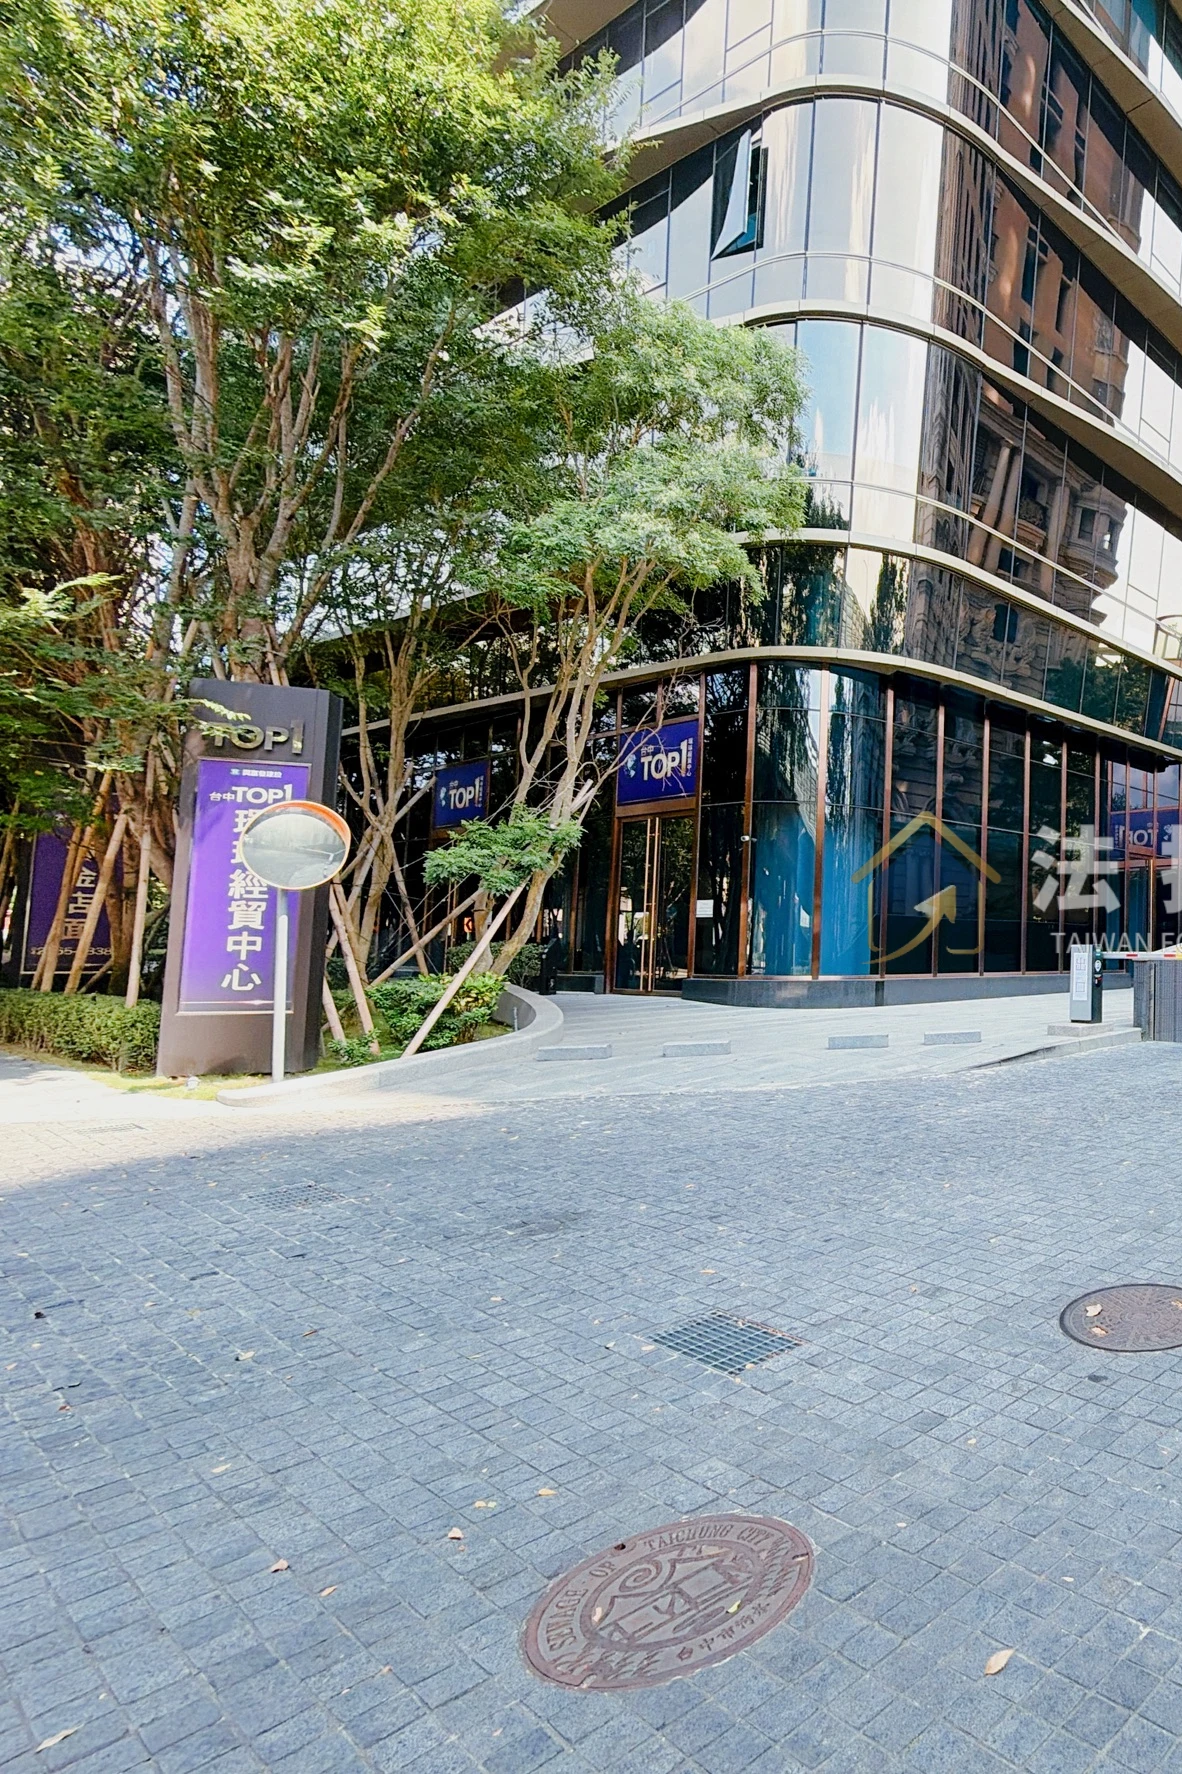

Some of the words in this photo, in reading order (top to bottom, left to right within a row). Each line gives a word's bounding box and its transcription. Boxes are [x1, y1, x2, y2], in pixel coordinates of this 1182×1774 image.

[206, 720, 304, 754] TOP1
[641, 739, 688, 780] TOP1
[449, 776, 480, 809] TOP1
[221, 809, 269, 991] 經貿中心
[644, 1524, 734, 1551] TAICHUNG
[737, 1526, 775, 1546] CITY
